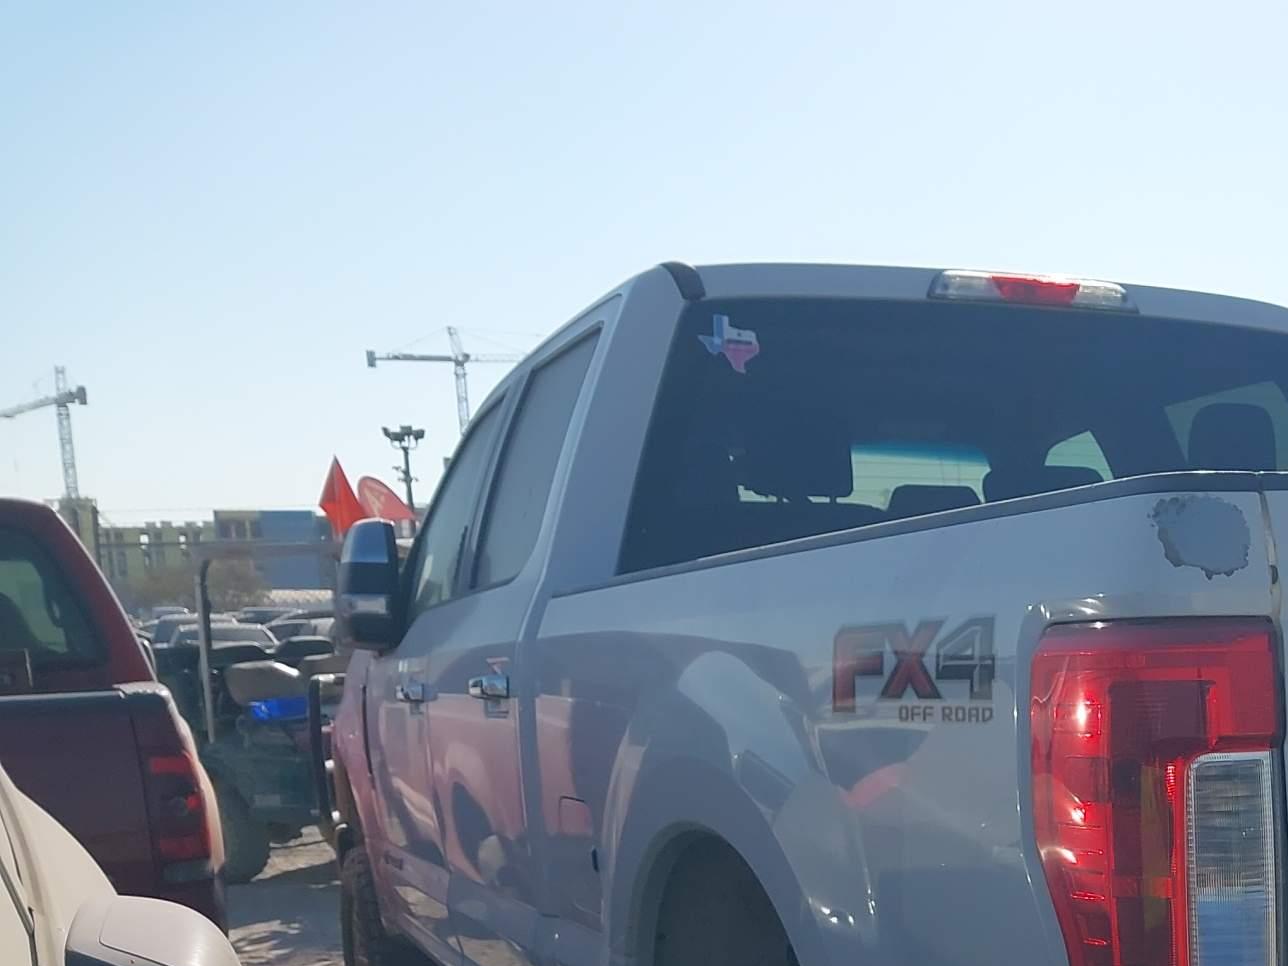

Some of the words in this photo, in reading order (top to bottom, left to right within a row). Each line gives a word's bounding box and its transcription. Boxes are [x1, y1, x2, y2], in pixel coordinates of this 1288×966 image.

[831, 614, 997, 713] FX4
[899, 705, 935, 723] OFF
[941, 705, 994, 723] ROAD
